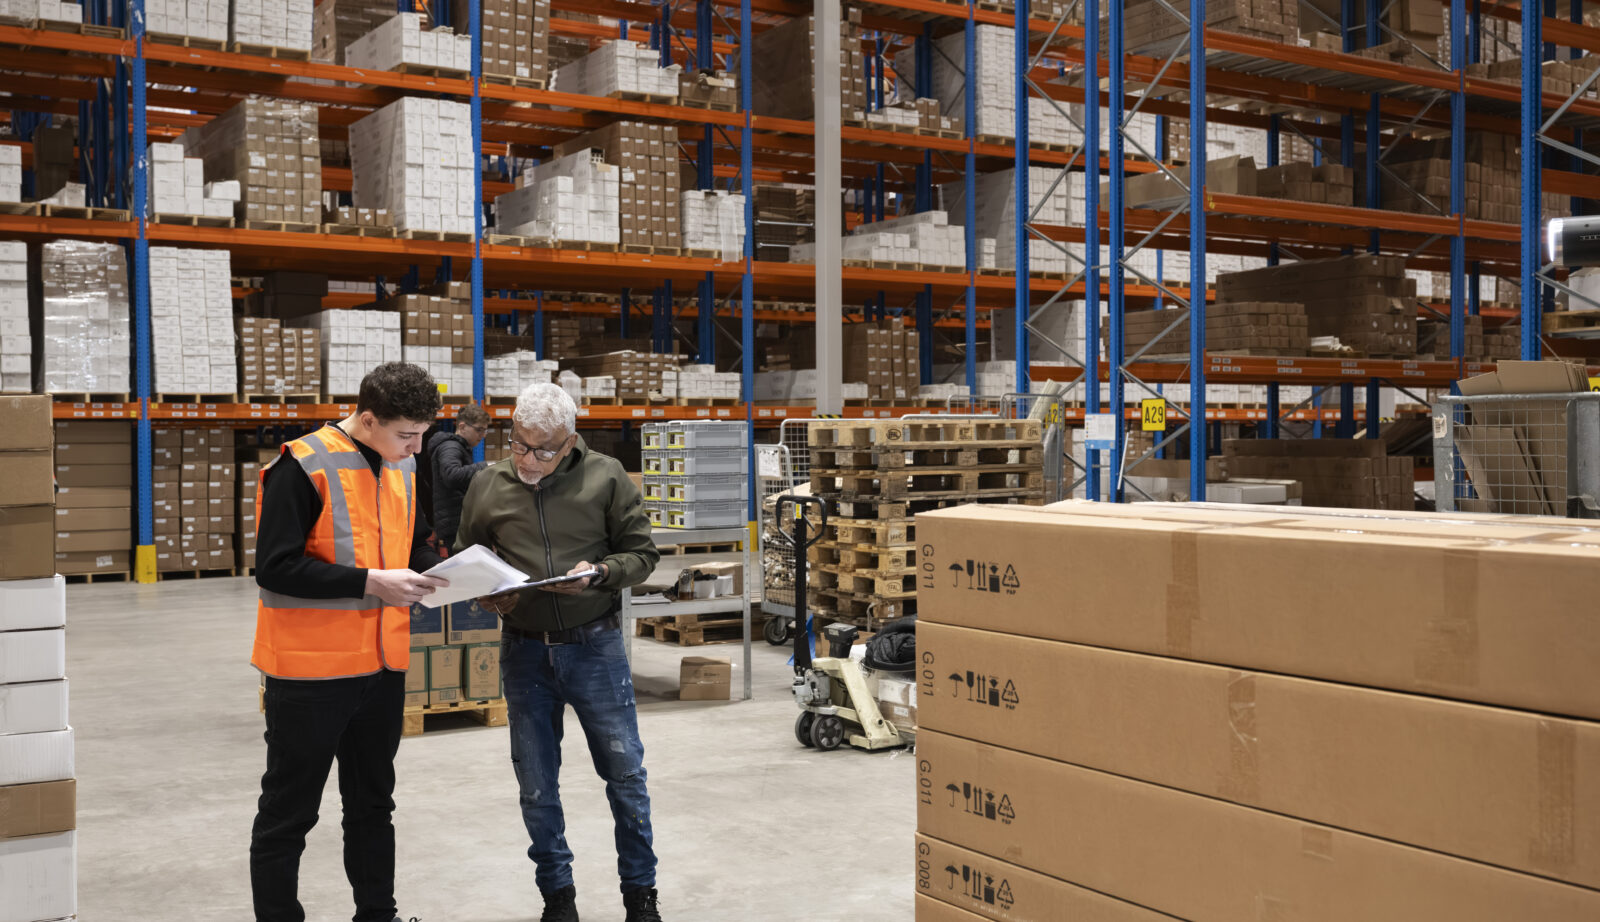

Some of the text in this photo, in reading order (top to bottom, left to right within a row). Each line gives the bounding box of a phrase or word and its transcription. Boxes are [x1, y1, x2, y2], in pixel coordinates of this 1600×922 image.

[1145, 406, 1163, 424] A29
[922, 543, 934, 589] G.011
[922, 651, 934, 697] G.011
[919, 759, 932, 806] G.011
[918, 842, 930, 890] G.008
